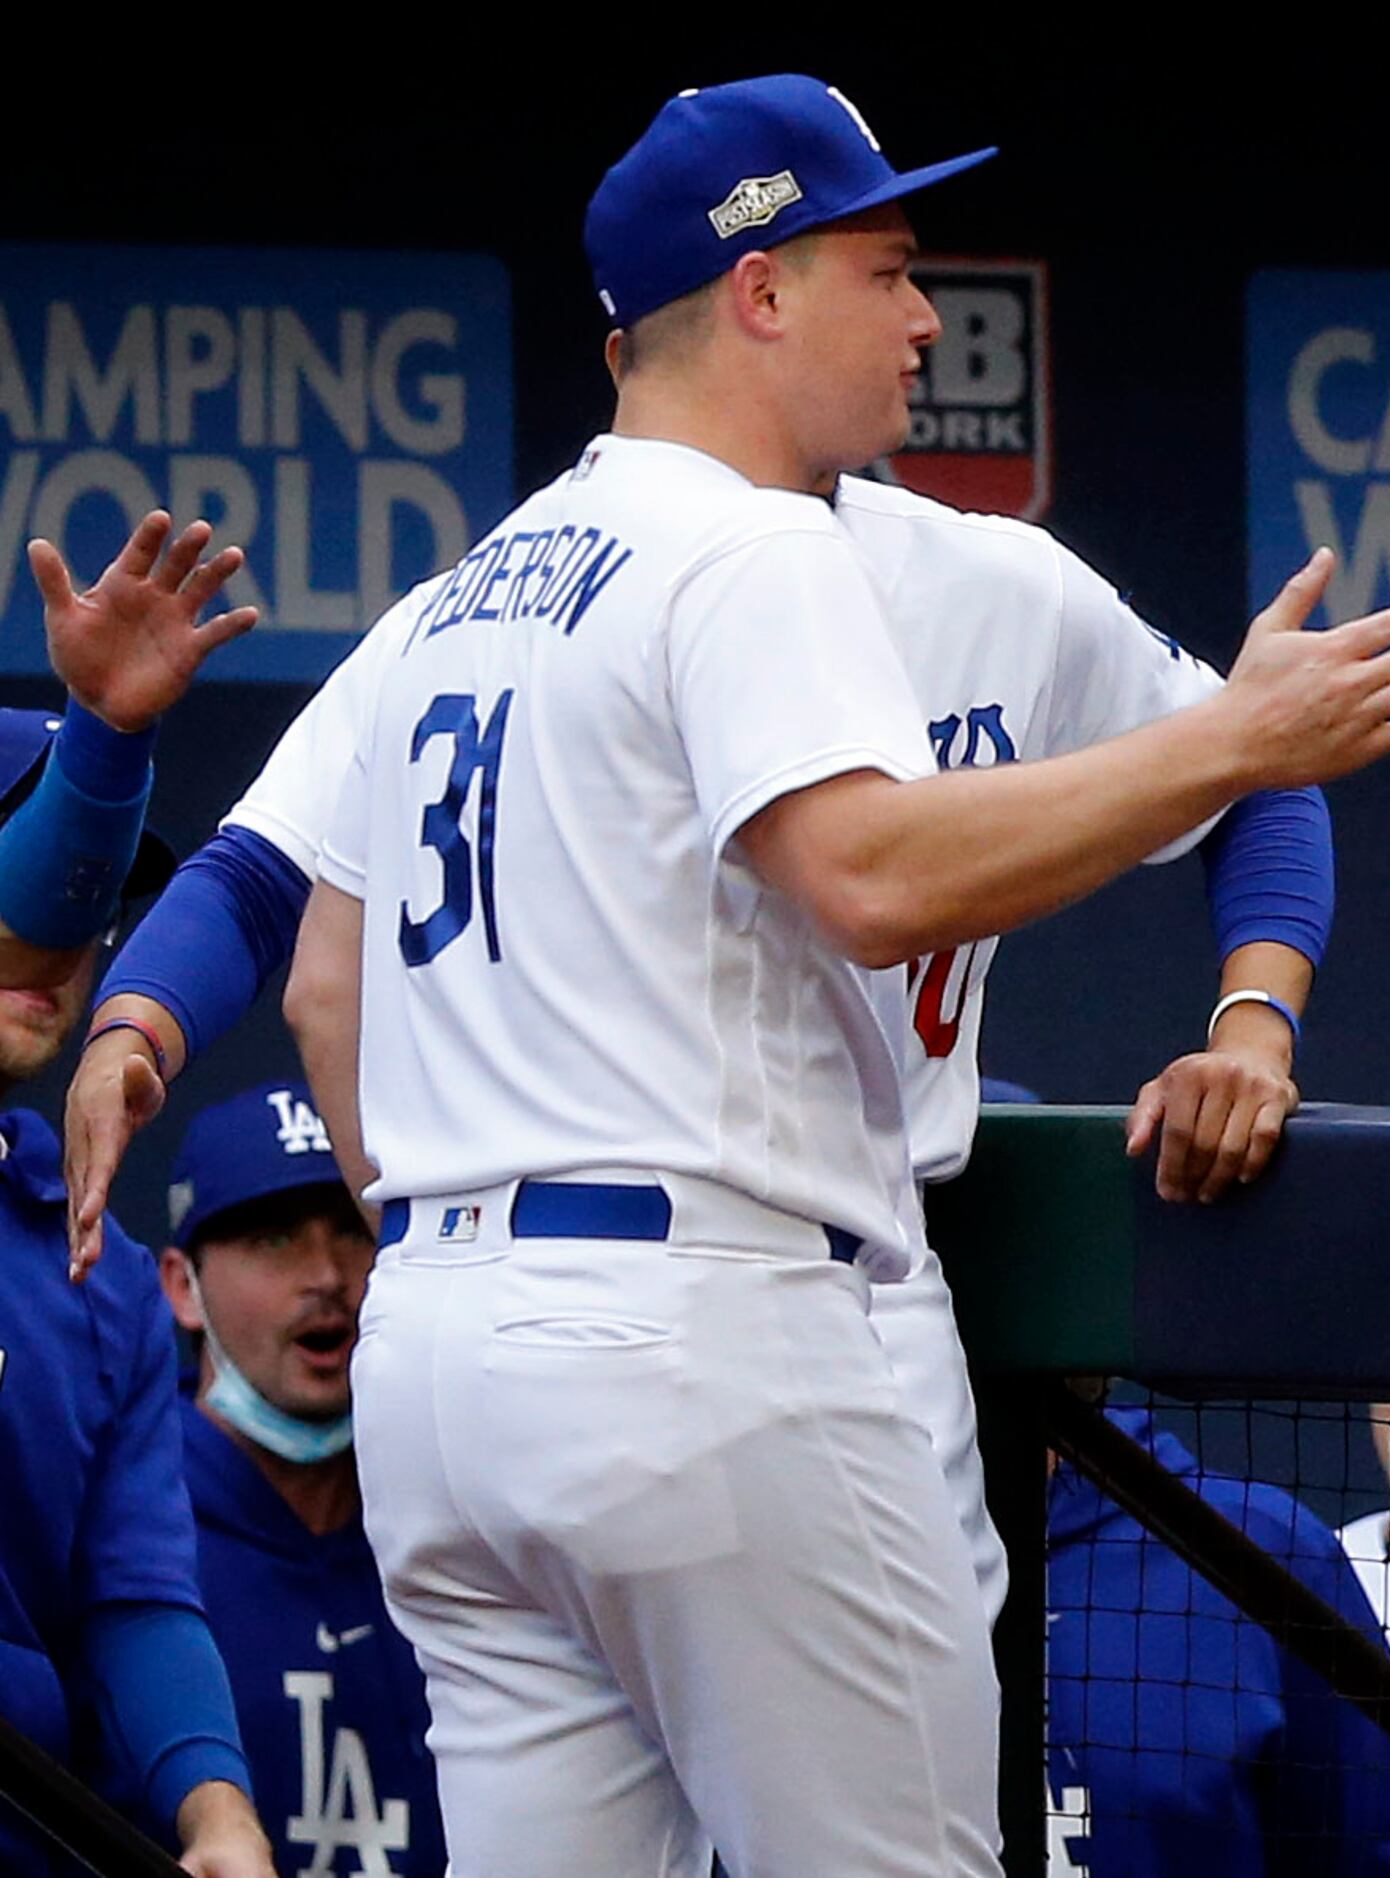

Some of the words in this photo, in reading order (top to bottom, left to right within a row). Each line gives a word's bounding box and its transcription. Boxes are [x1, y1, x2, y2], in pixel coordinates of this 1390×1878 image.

[0, 447, 468, 634] ORLD
[399, 688, 514, 968] 31
[266, 1090, 332, 1153] LA
[283, 1670, 411, 1878] LA
